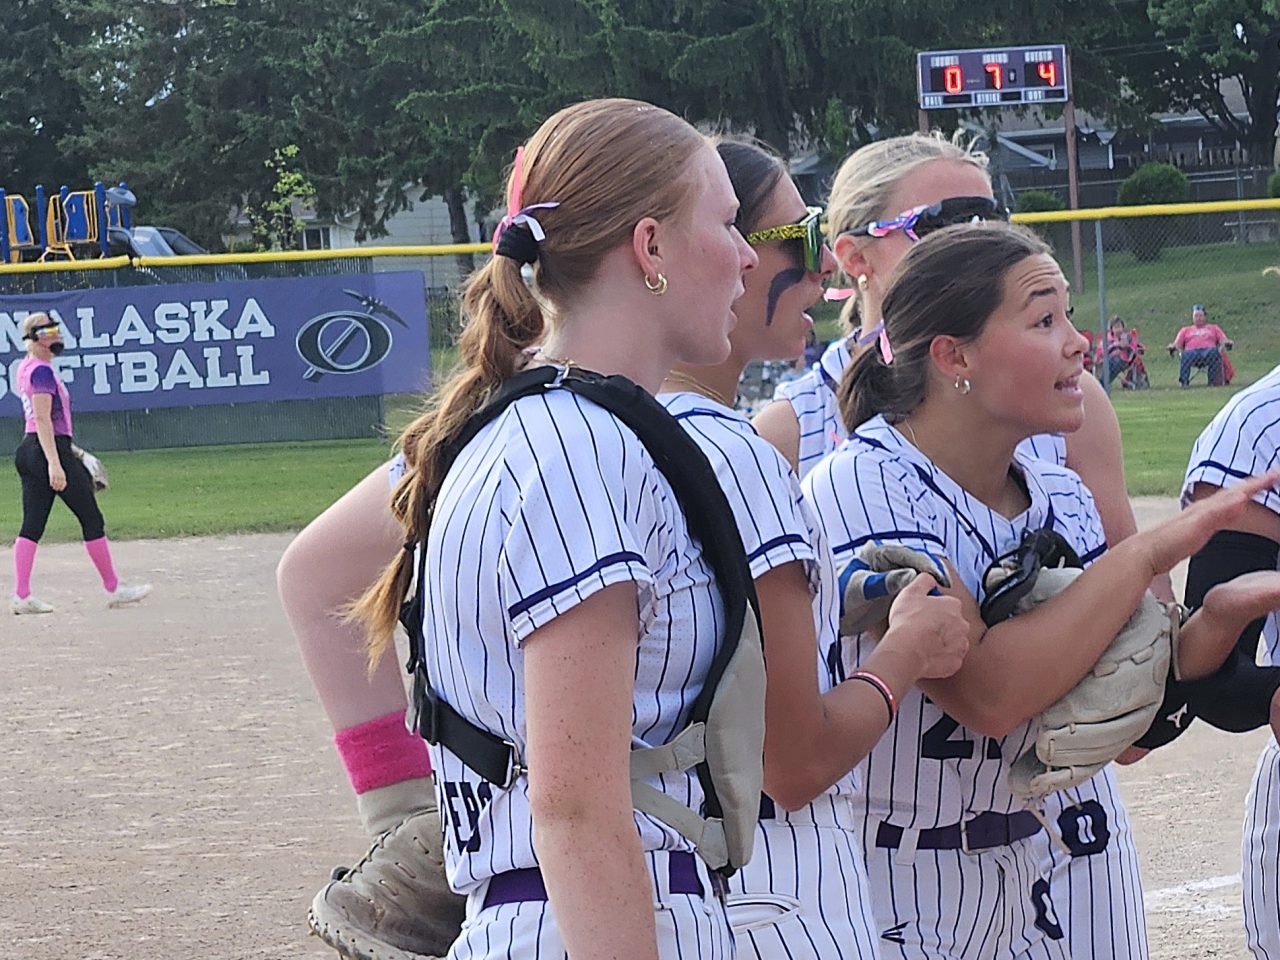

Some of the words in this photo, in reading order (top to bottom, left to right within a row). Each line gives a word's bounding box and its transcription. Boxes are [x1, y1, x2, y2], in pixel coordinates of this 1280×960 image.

[944, 65, 962, 94] 0
[985, 63, 1002, 90] 7
[1037, 61, 1056, 87] 4
[0, 345, 270, 400] FTBALL
